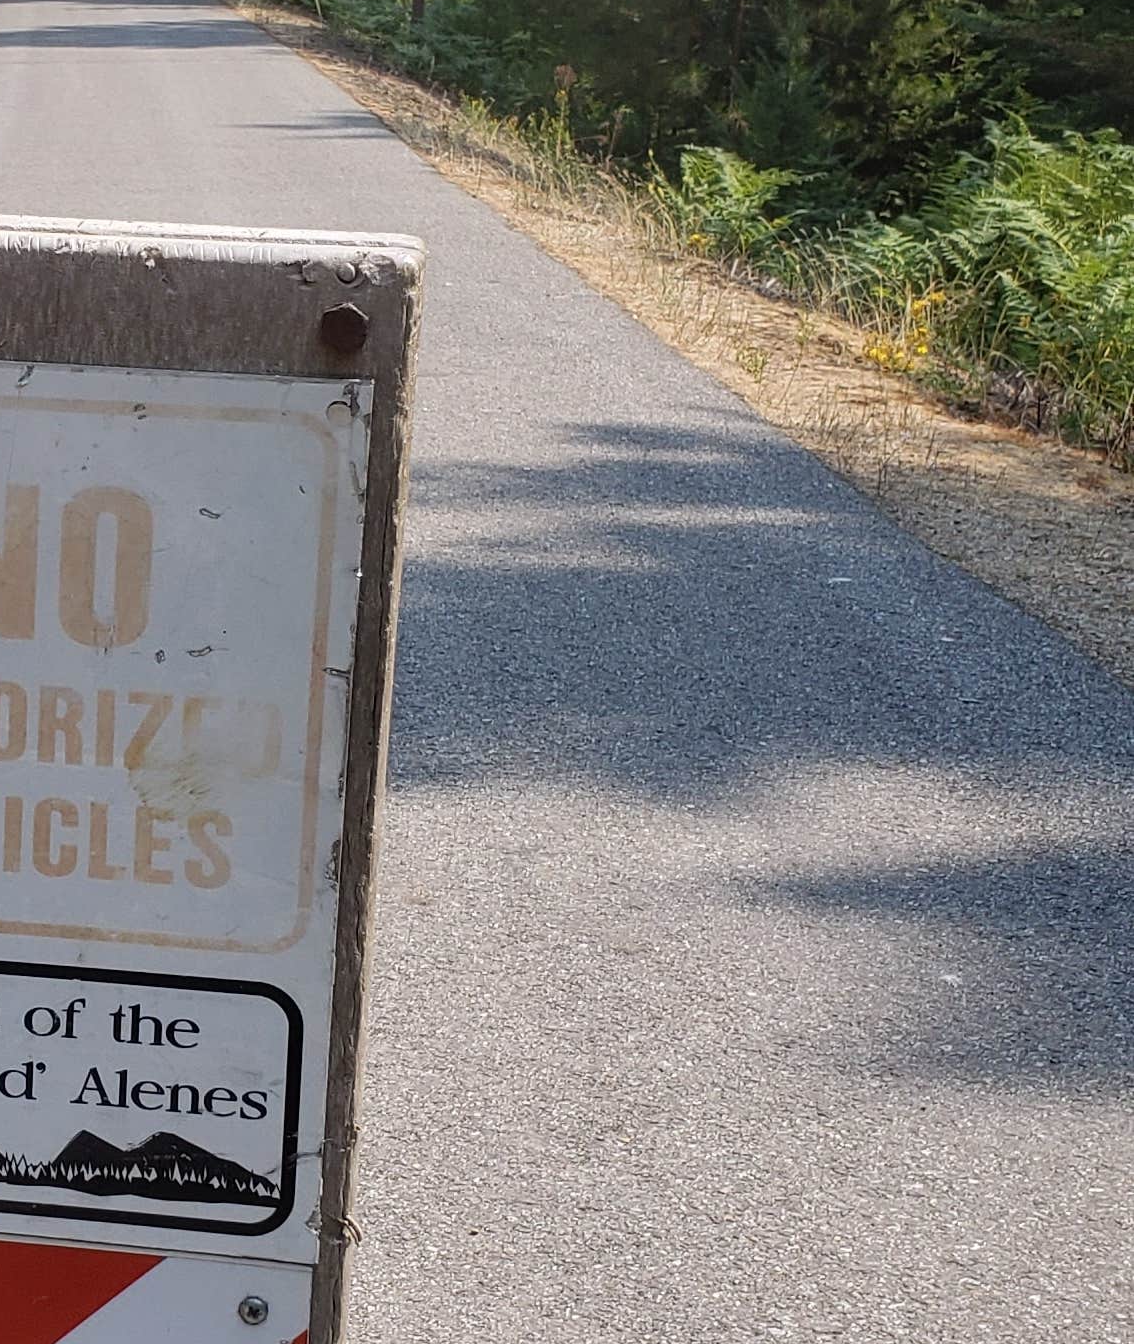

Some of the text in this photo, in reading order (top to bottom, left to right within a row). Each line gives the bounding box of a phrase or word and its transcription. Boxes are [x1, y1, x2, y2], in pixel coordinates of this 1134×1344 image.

[24, 998, 85, 1039] of
[111, 1004, 200, 1048] the
[70, 1067, 268, 1120] Alenes
